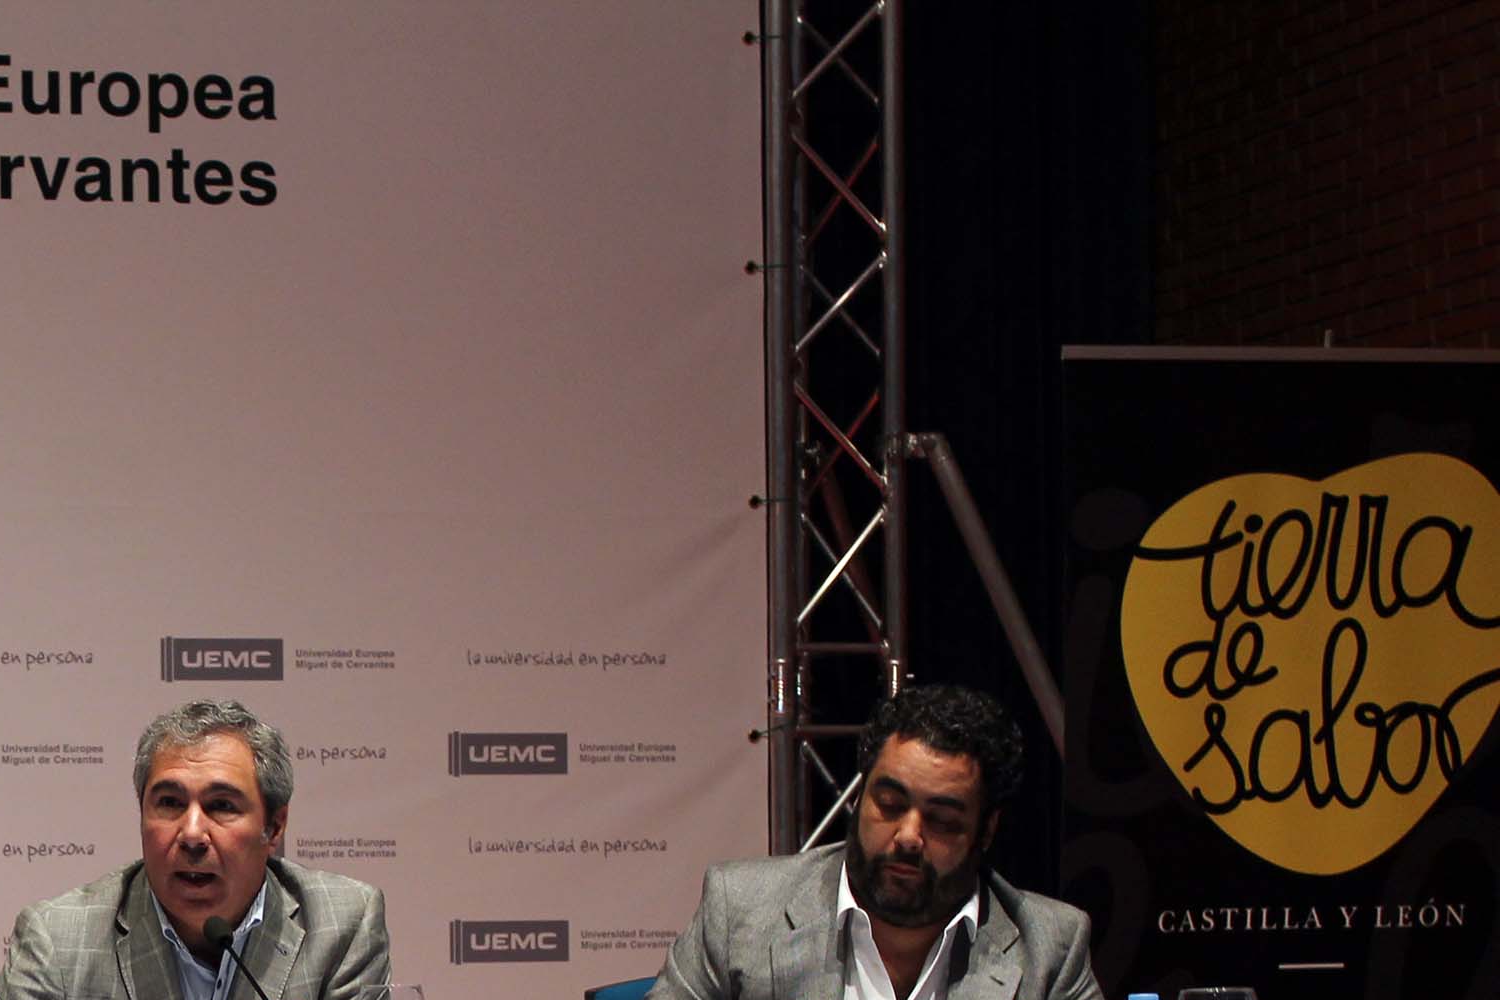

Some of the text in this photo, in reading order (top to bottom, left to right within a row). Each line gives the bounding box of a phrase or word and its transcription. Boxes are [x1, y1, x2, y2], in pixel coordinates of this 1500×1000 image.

[1134, 490, 1500, 628] tierra
[1, 652, 21, 664] en
[26, 651, 92, 670] persona
[182, 651, 271, 668] UEMC
[296, 649, 395, 659] Universidad Europea
[468, 649, 666, 671] la universidad en persona
[1163, 622, 1278, 701] de
[296, 660, 395, 671] Miguel de Cervantes
[1184, 617, 1500, 815] sabor
[2, 744, 103, 754] Universidad Europea
[297, 746, 386, 766] en persona
[469, 745, 555, 762] UEMC
[579, 743, 676, 752] Universidad Europea
[2, 755, 103, 766] Miguel de Cervantes
[580, 754, 676, 764] Miguel de Cervantes
[297, 838, 396, 848] Universidad Europea
[469, 837, 667, 858] la universidad en persona
[3, 844, 22, 856] en
[27, 843, 94, 862] persona
[297, 849, 396, 860] Miguel de Cervantes
[1159, 899, 1464, 932] CASTILLA Y LEÓN
[471, 932, 556, 950] UEMC
